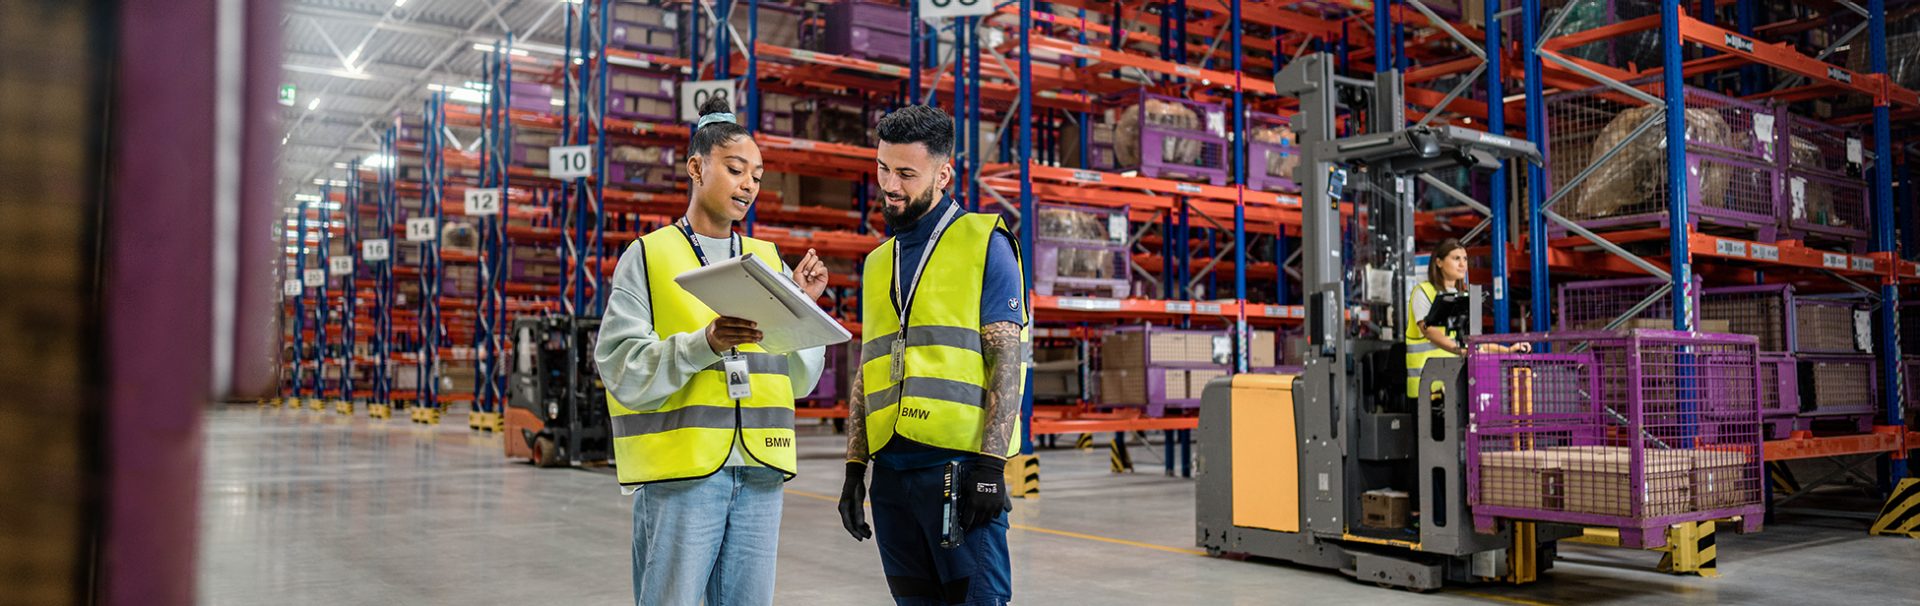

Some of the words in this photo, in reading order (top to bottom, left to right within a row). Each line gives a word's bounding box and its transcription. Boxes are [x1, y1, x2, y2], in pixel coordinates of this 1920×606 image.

[559, 152, 587, 172] 10
[471, 193, 494, 210] 12
[411, 223, 430, 236] 14
[368, 243, 384, 256] 16
[334, 260, 349, 271] 18
[901, 406, 930, 420] BMW
[765, 437, 791, 448] BMW
